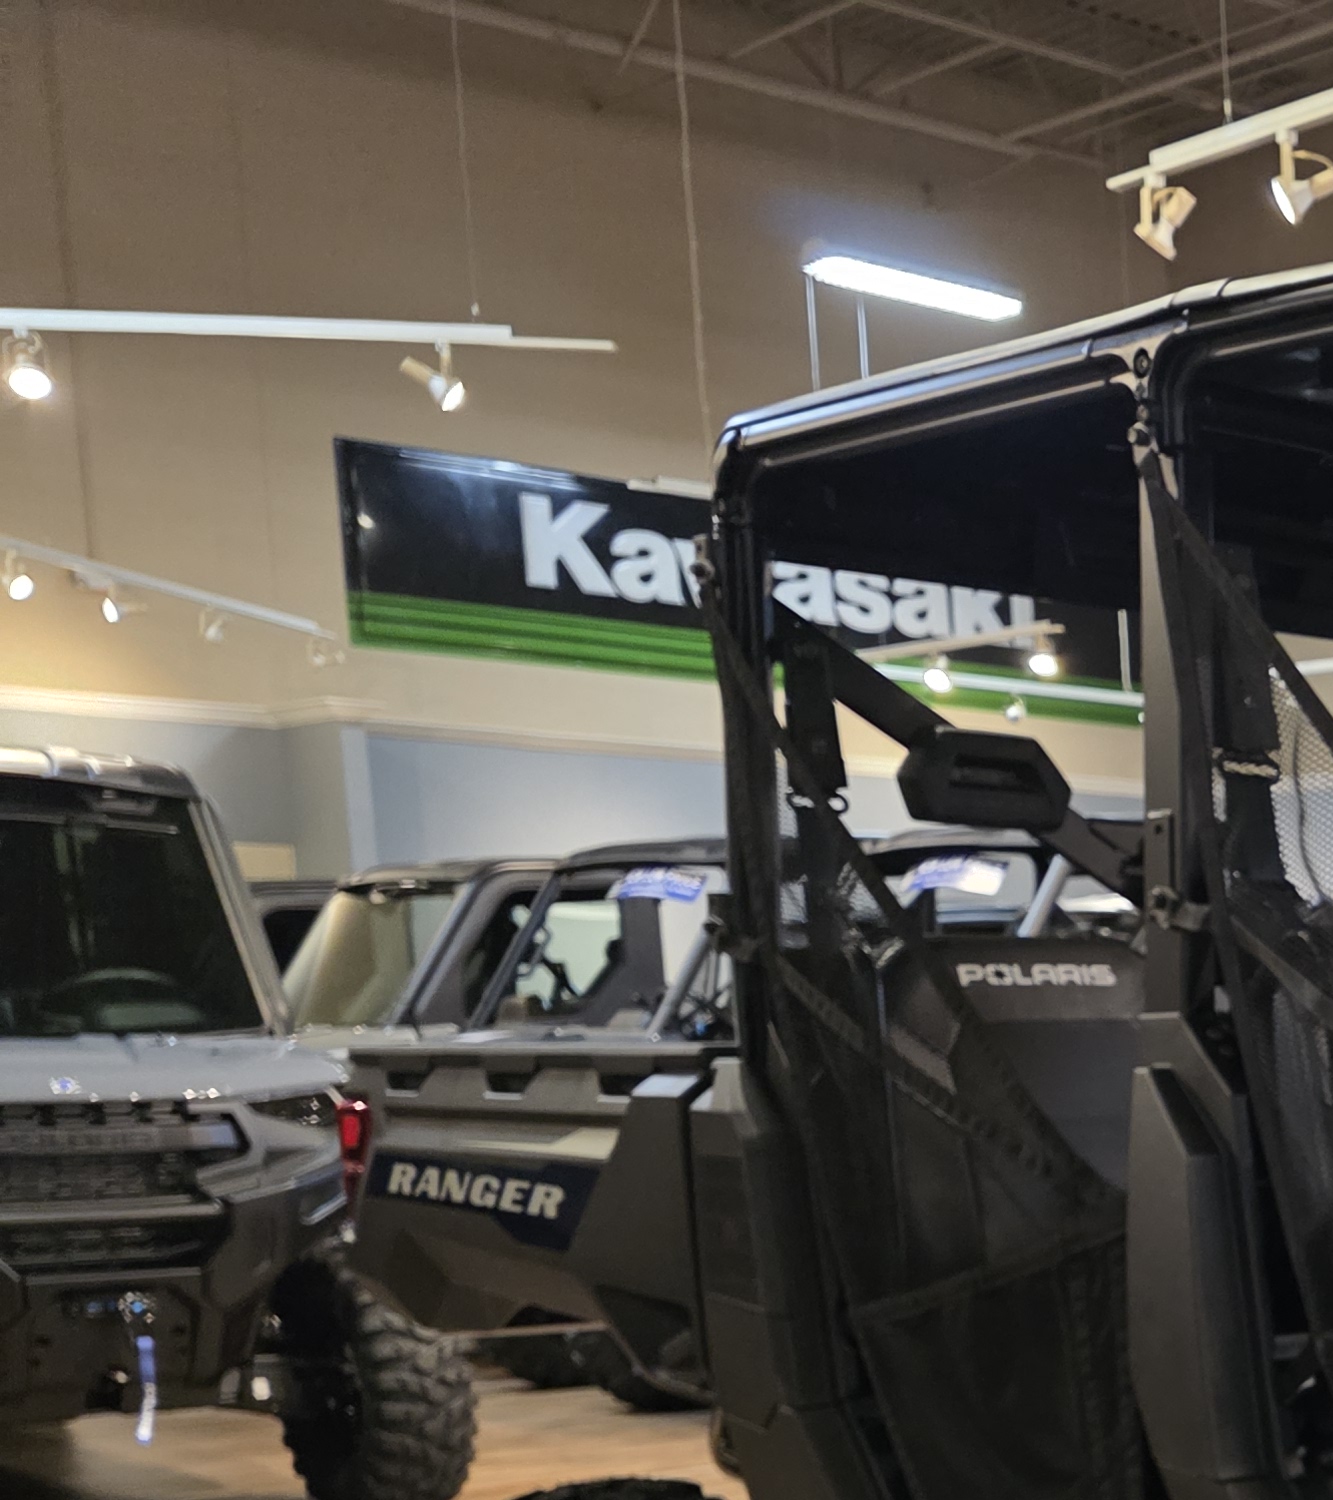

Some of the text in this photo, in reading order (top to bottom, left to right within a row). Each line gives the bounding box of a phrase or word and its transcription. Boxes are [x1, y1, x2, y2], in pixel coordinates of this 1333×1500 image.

[519, 492, 1036, 649] Kaasaki
[956, 963, 1117, 987] POLARIS
[387, 1161, 566, 1219] RANGER
